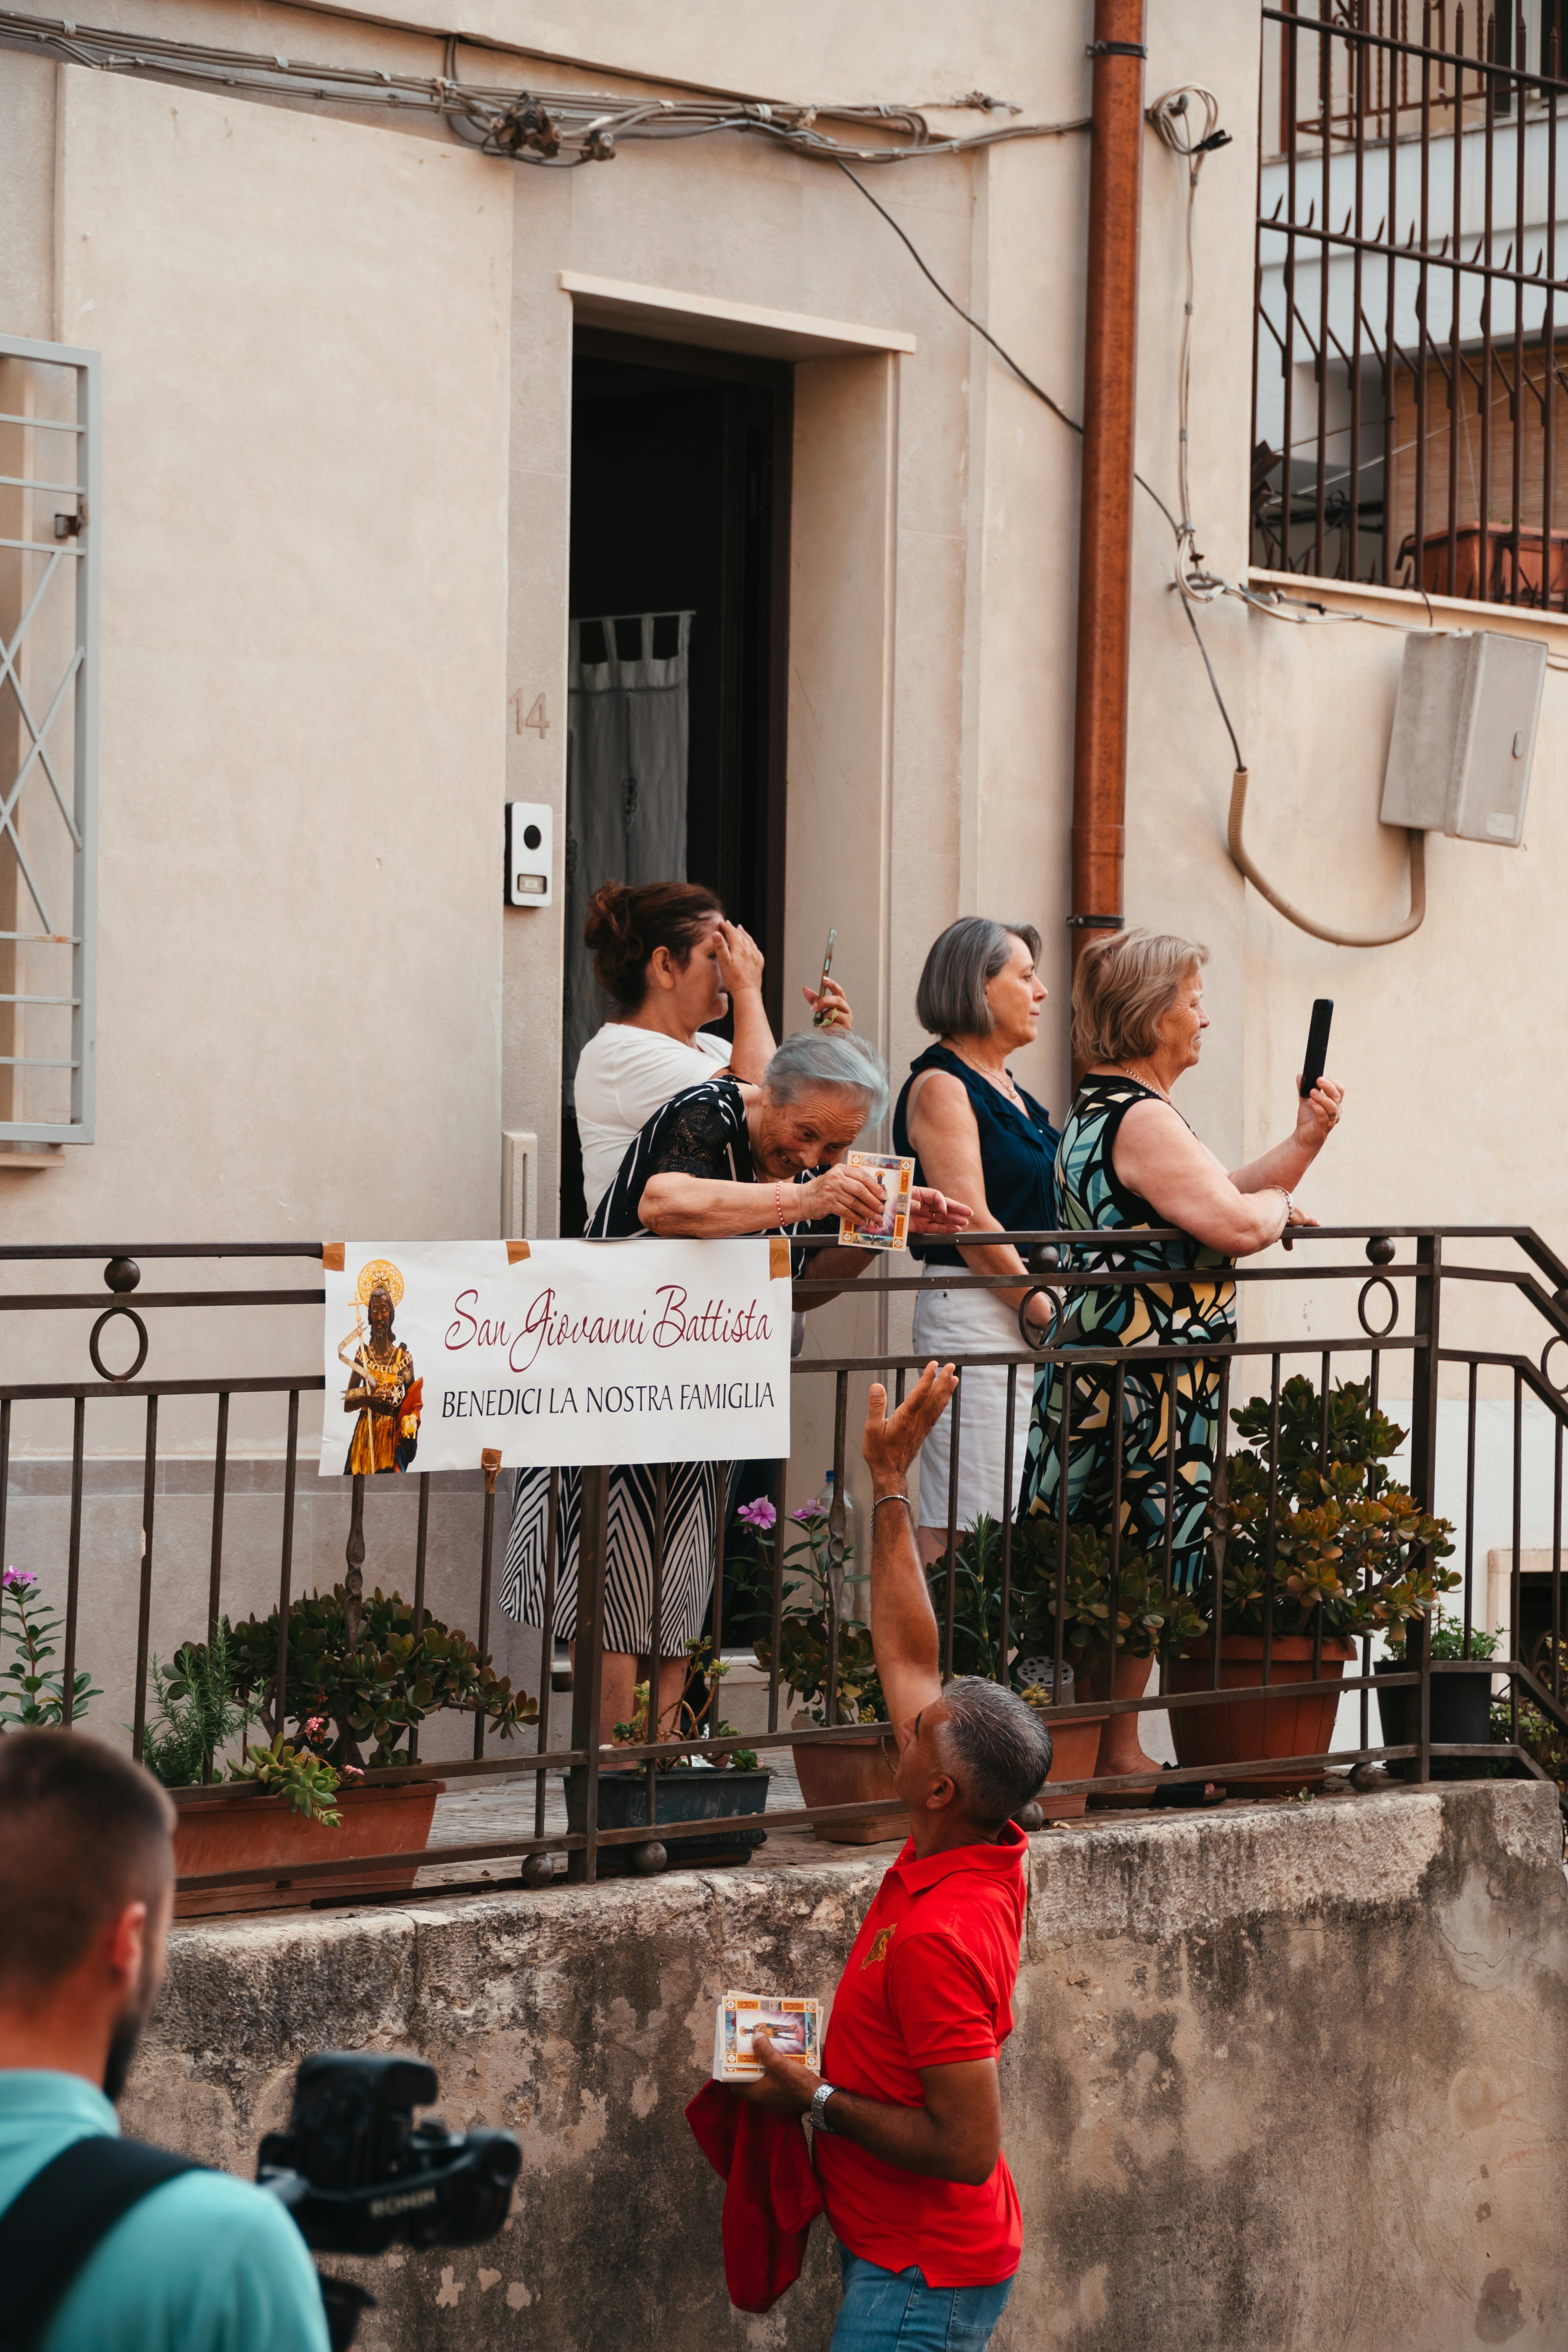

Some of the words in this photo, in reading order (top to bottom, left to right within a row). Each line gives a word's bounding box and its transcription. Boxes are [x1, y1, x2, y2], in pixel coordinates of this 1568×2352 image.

[509, 688, 550, 739] 14
[445, 1289, 512, 1351] San
[509, 1287, 649, 1373] Giovanni
[653, 1284, 773, 1348] Battista
[441, 1388, 542, 1418] BENEDICI
[549, 1387, 578, 1414] LA
[586, 1385, 673, 1413] NOSTRA
[680, 1382, 775, 1410] FAMIGLIA
